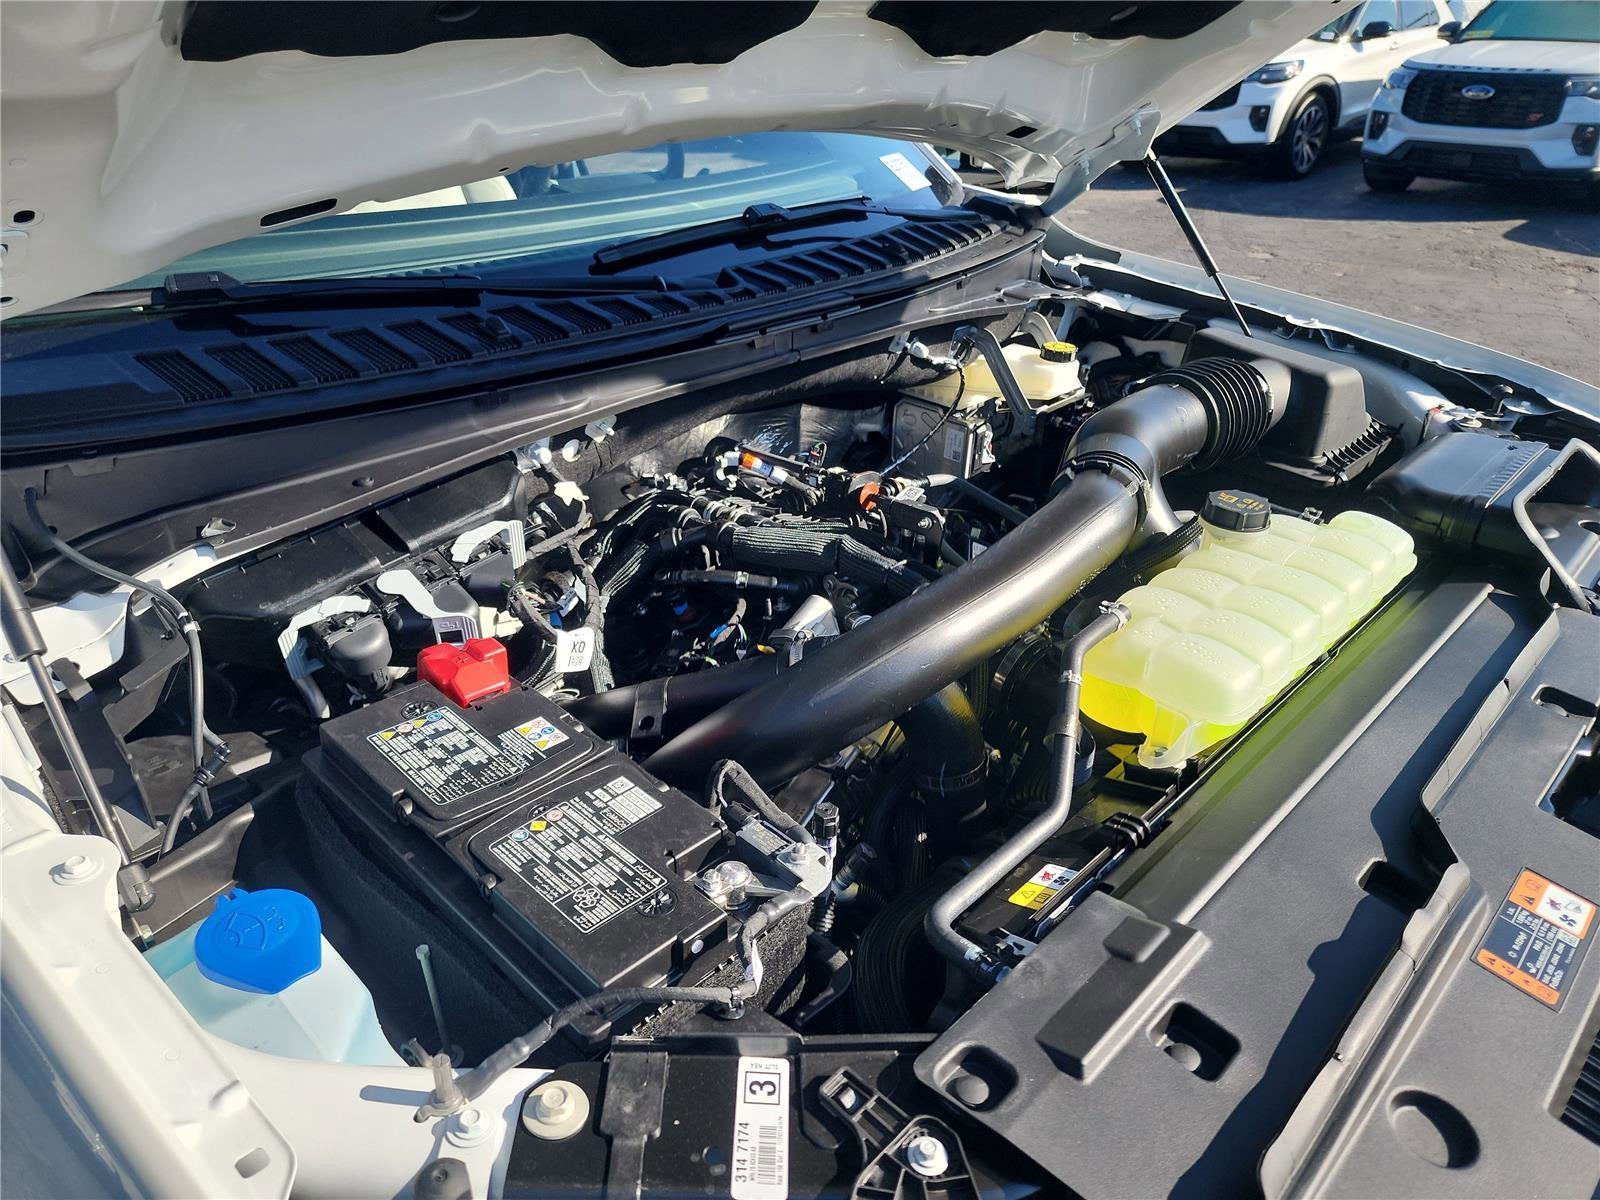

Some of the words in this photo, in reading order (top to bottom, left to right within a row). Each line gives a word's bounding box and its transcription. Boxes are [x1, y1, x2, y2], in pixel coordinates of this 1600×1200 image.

[750, 1080, 776, 1096] 3
[737, 1121, 750, 1153] 7174
[735, 1158, 748, 1183] 314
